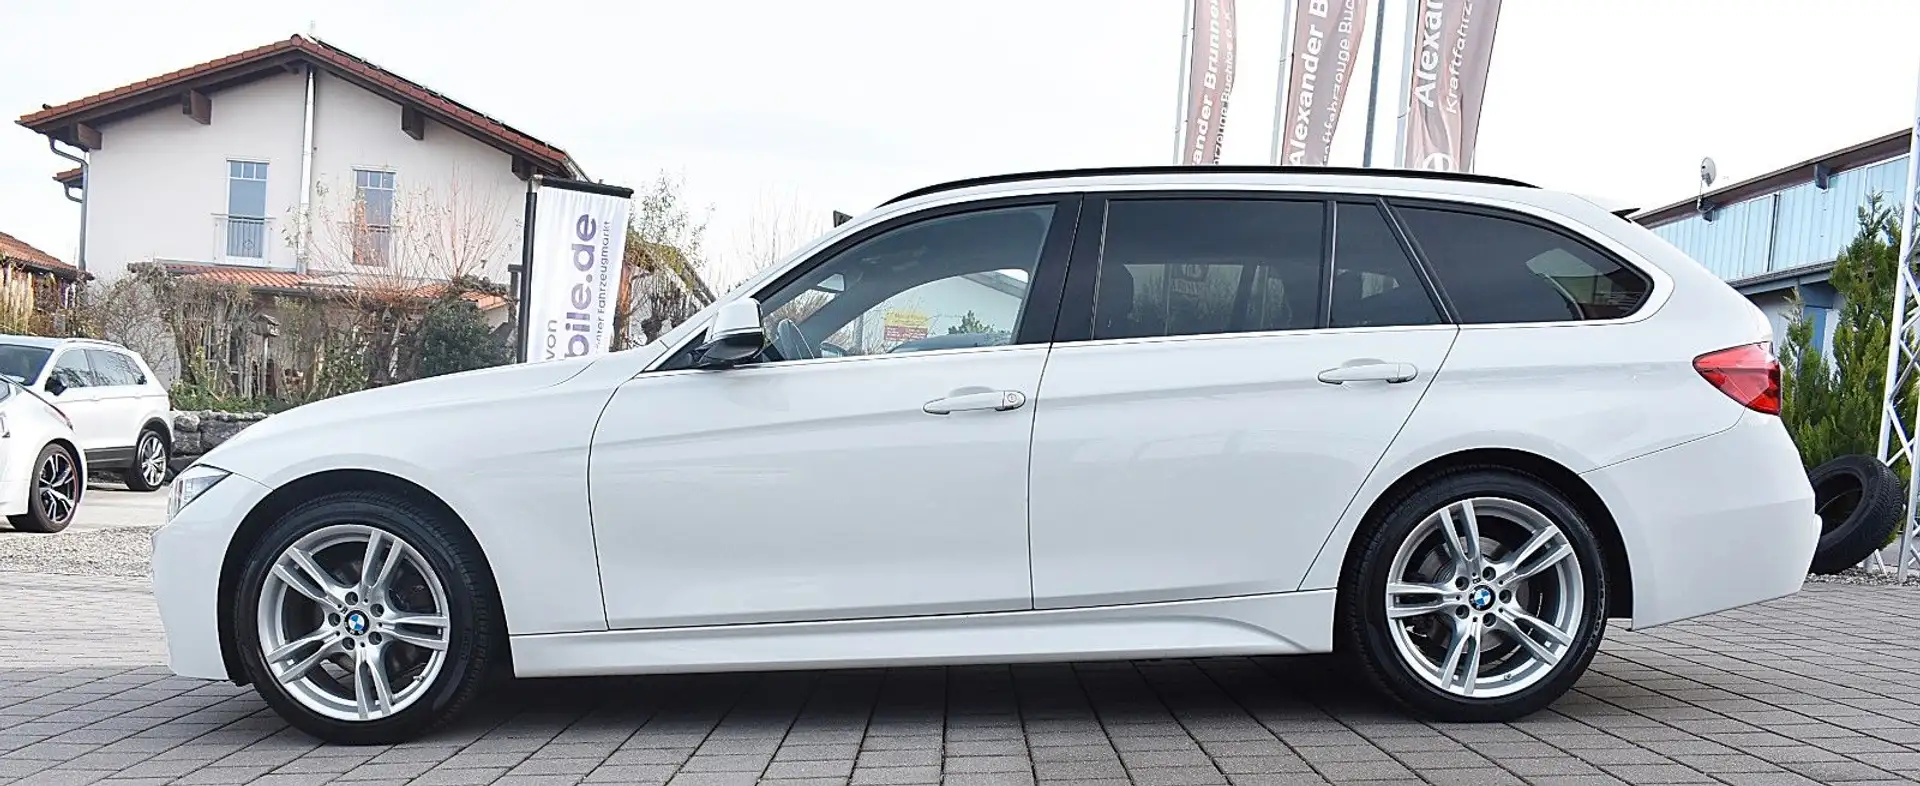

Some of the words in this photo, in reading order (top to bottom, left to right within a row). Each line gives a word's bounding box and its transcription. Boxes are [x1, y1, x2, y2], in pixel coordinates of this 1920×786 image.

[1289, 24, 1324, 165] Alexander
[1445, 0, 1473, 114] Kraftfahrz
[1190, 93, 1214, 165] ander
[597, 220, 610, 314] Fahrzeugmarkt
[545, 319, 558, 361] von
